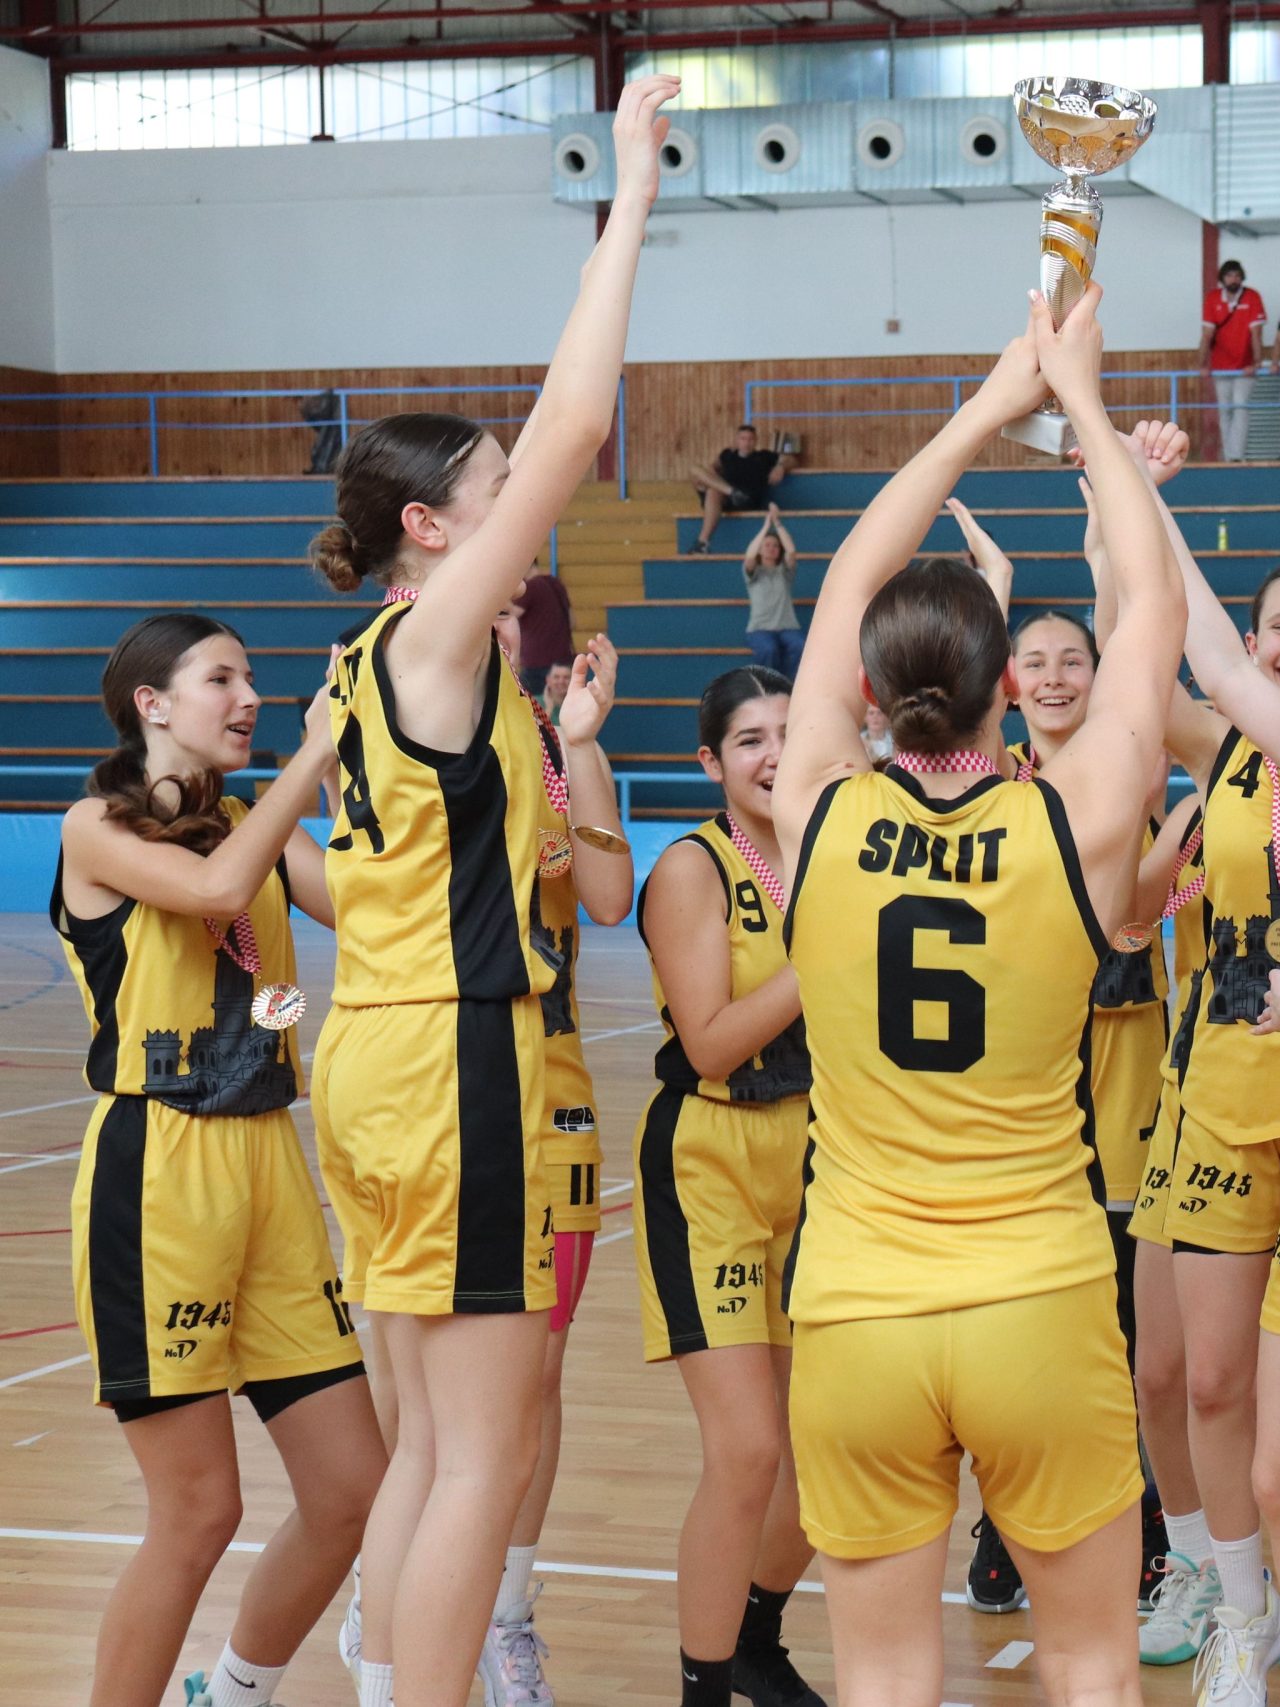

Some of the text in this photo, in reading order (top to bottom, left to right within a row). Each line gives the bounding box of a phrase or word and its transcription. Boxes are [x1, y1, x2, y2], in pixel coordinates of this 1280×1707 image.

[1227, 751, 1263, 798] 4
[858, 819, 1007, 884] SPLIT
[736, 880, 768, 933] 9
[877, 894, 986, 1073] 6
[1145, 1166, 1171, 1190] 19
[1186, 1162, 1252, 1197] 1945
[165, 1300, 231, 1330] 1945
